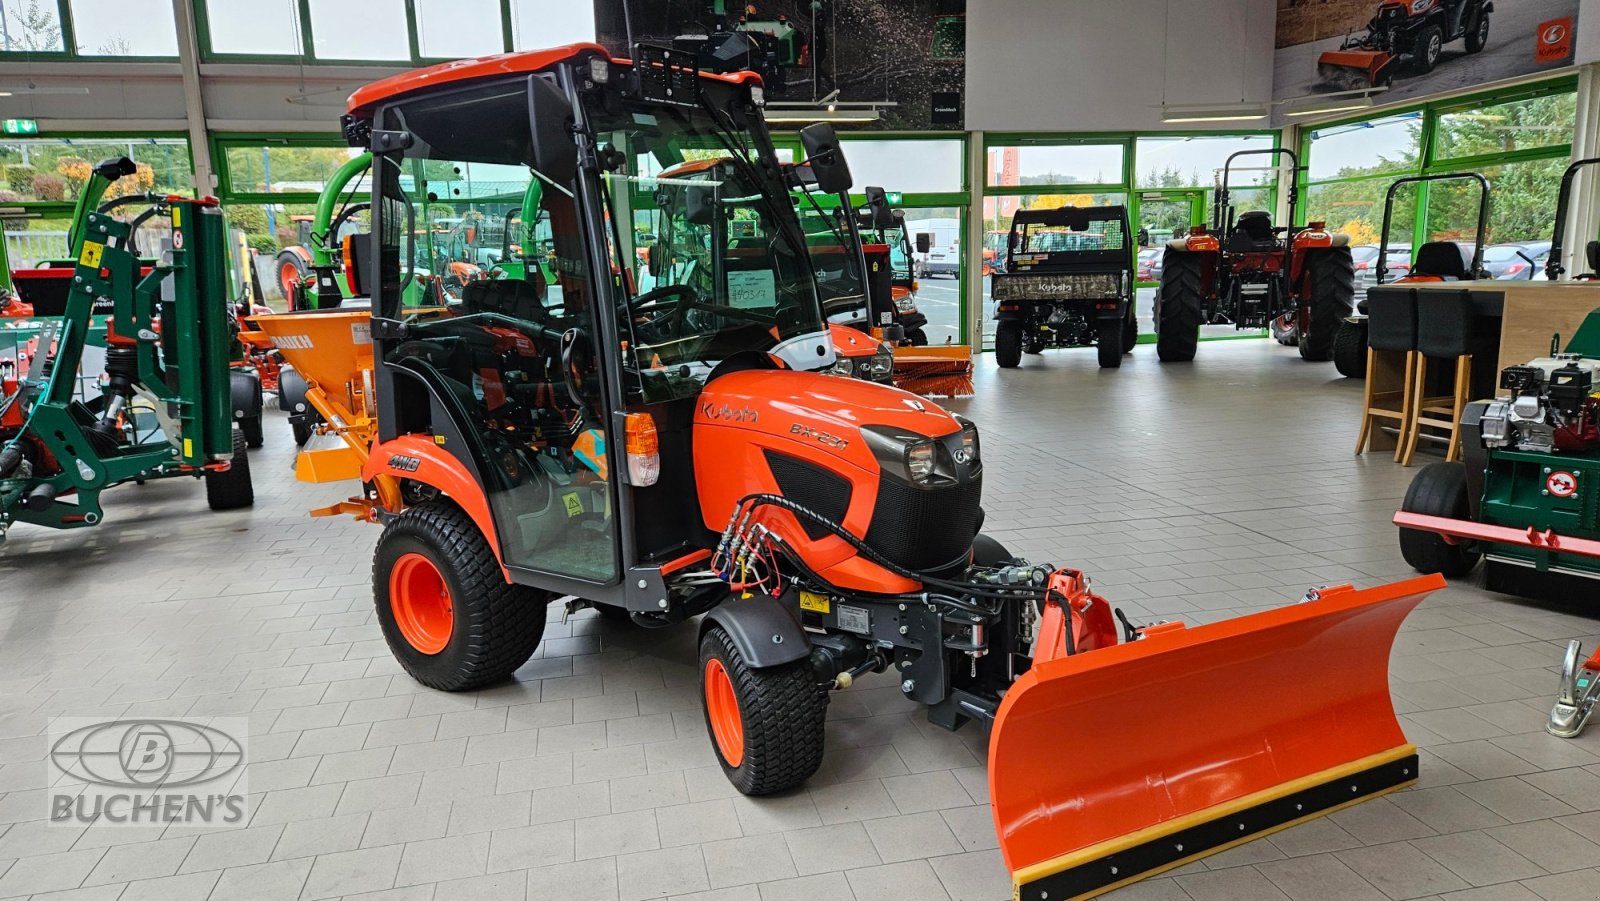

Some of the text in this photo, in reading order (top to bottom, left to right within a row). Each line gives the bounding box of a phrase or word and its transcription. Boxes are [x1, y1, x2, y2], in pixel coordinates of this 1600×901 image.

[1038, 283, 1072, 292] Kubota
[700, 402, 759, 423] Kubota
[387, 454, 421, 472] 4WD
